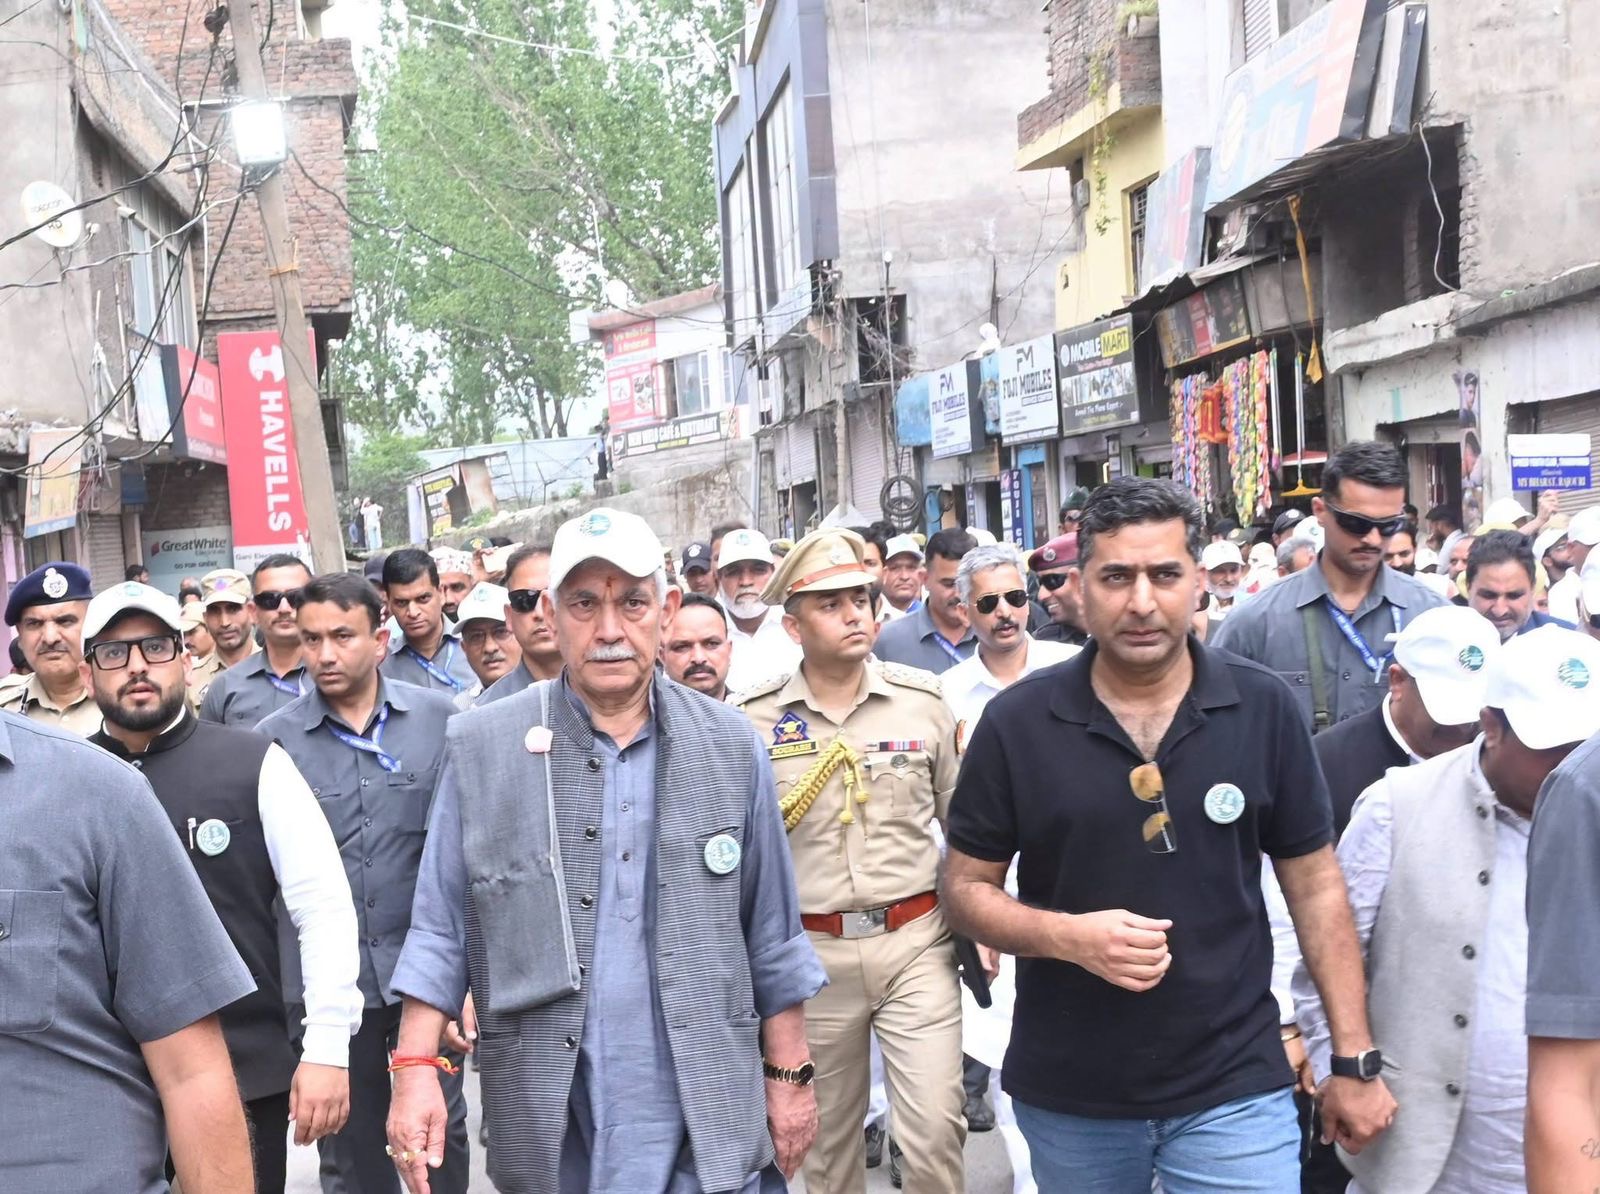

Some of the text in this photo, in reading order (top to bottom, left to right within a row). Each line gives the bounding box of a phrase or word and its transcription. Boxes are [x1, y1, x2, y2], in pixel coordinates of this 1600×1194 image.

[1071, 330, 1127, 364] MOBILE MART
[1019, 368, 1052, 395] MOBILES
[259, 390, 292, 532] HAVELLS
[161, 538, 227, 552] GreatWhite
